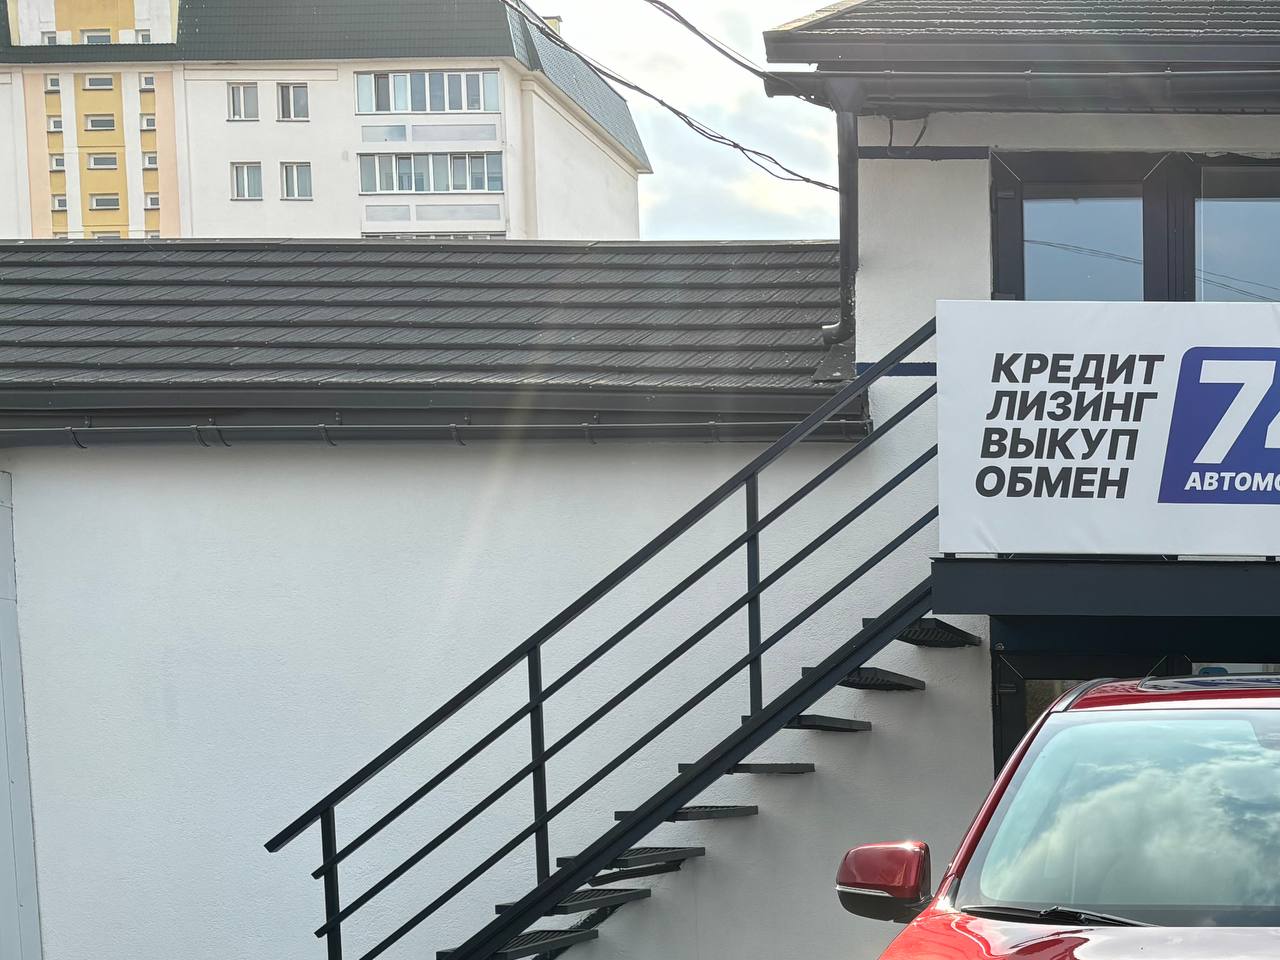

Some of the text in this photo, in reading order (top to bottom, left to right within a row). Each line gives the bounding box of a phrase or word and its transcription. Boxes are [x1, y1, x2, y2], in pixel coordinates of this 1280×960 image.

[992, 352, 1165, 391] КРЕДИТ
[986, 390, 1159, 422] ЛИЗИНГ
[980, 427, 1138, 461] ВЫКУП
[975, 465, 1129, 499] ОБМЕН
